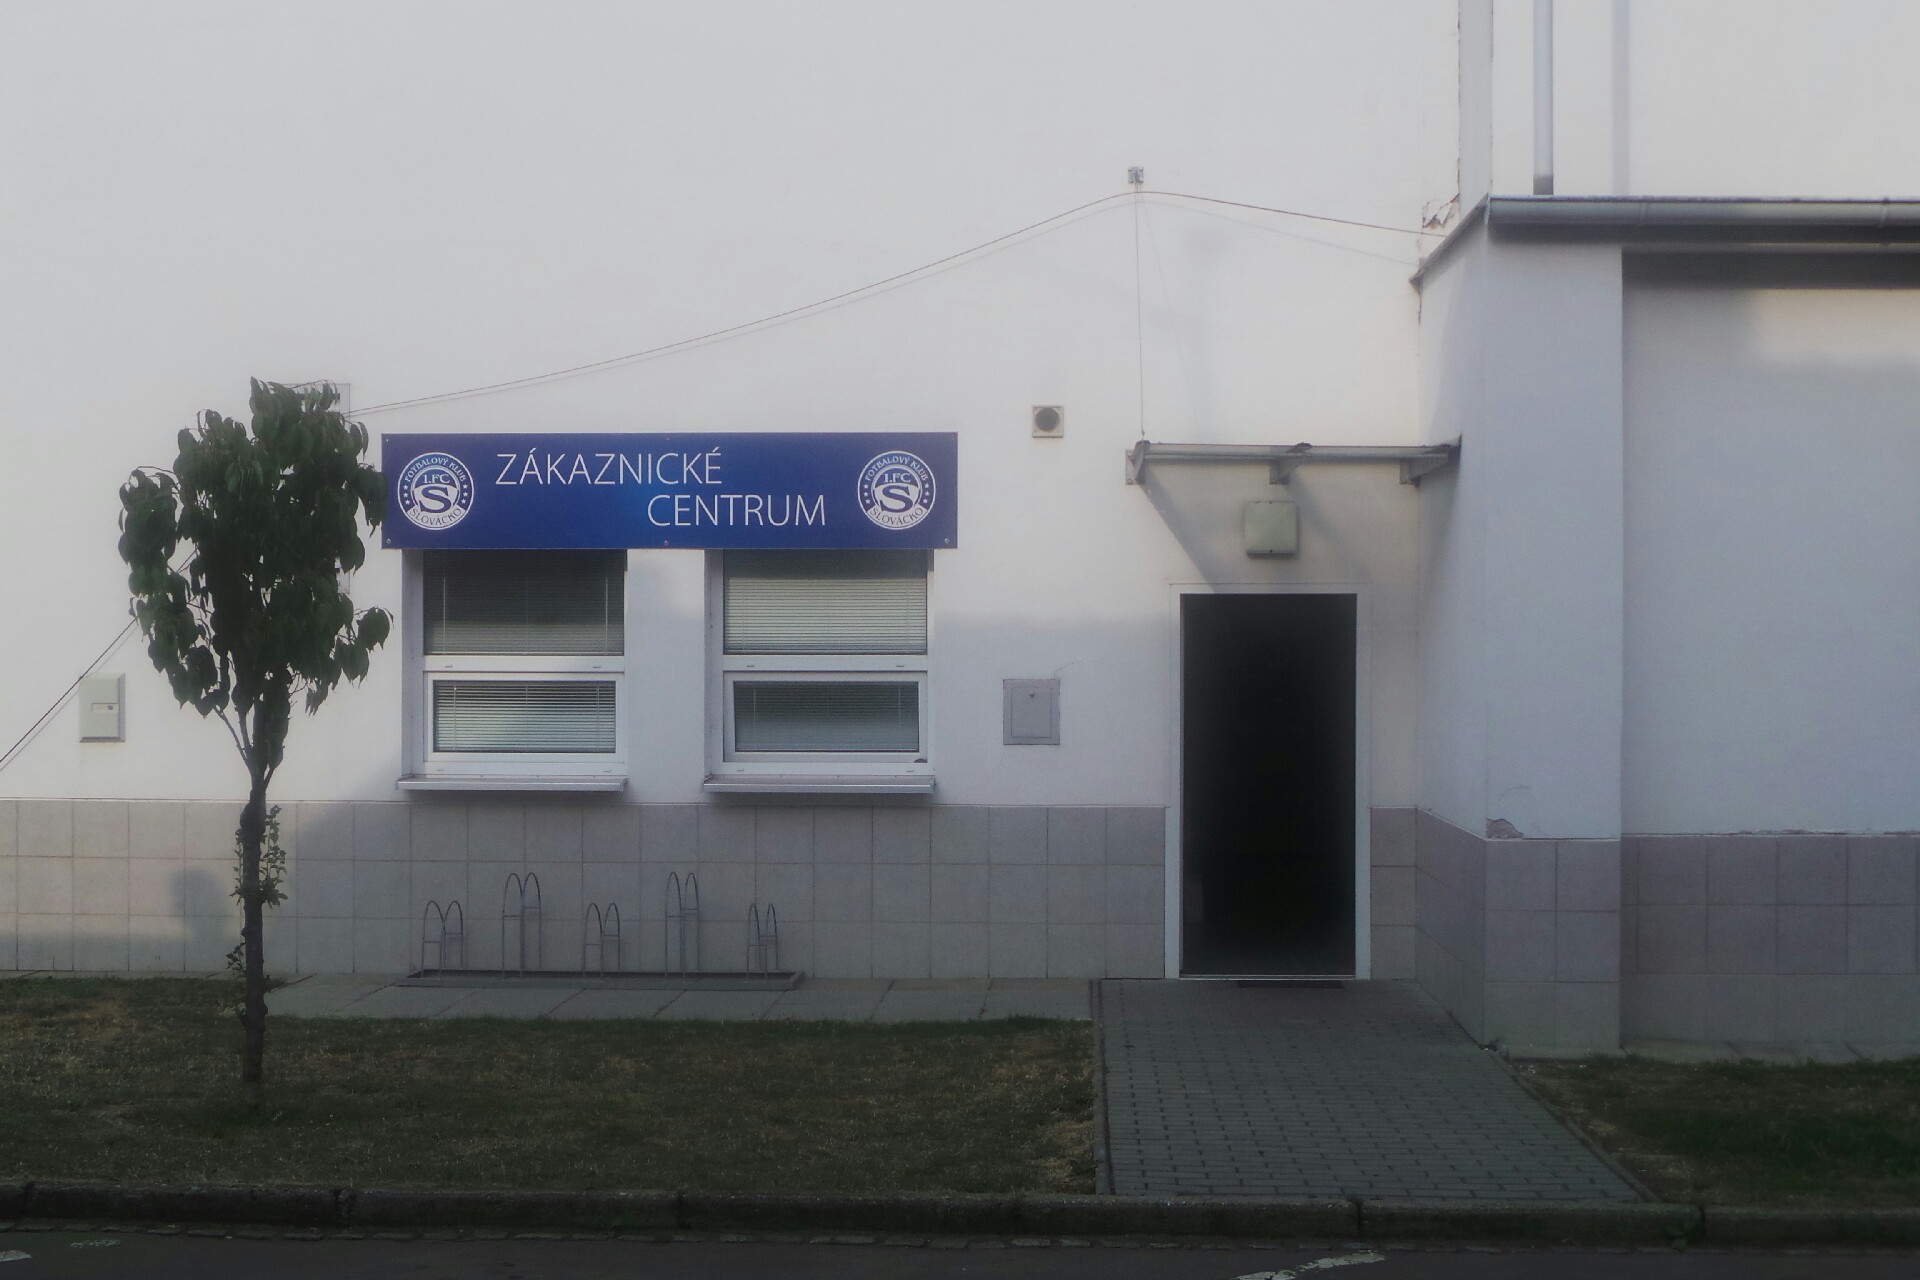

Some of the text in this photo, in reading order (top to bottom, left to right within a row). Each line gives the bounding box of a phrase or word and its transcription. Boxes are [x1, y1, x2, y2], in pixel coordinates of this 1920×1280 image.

[404, 457, 467, 483] FOTBALOVÝ KLUB
[495, 446, 723, 486] ZÁKAZNICKÉ
[864, 455, 929, 482] FOTBALOVÝ KLUB
[419, 485, 452, 514] S
[647, 494, 826, 527] CENTRUM
[879, 484, 914, 513] S
[409, 507, 462, 526] SLOVÁCKO
[869, 507, 924, 526] SLOVÁCKO
